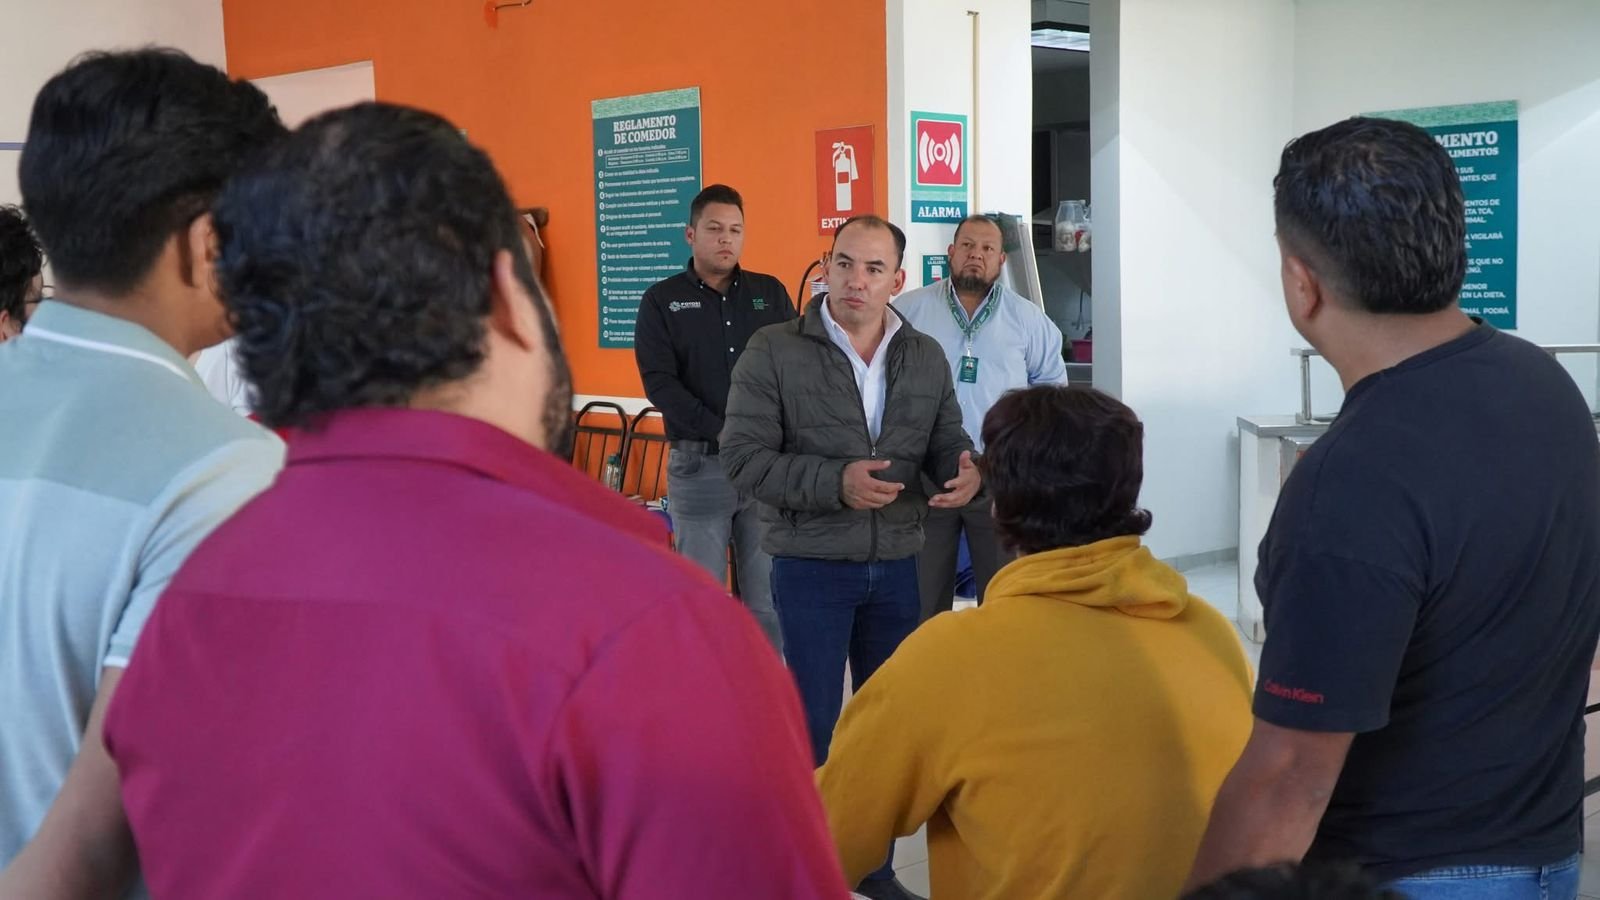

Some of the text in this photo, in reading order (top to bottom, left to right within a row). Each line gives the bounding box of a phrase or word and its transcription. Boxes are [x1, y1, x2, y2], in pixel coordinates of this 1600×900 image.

[613, 115, 676, 132] REGLAMENTO
[614, 128, 676, 144] DE COMEDOR
[1481, 173, 1496, 182] QUE
[1490, 198, 1500, 206] DE
[918, 206, 961, 218] ALARMA
[1475, 258, 1491, 266] QUE
[1462, 291, 1472, 299] EN
